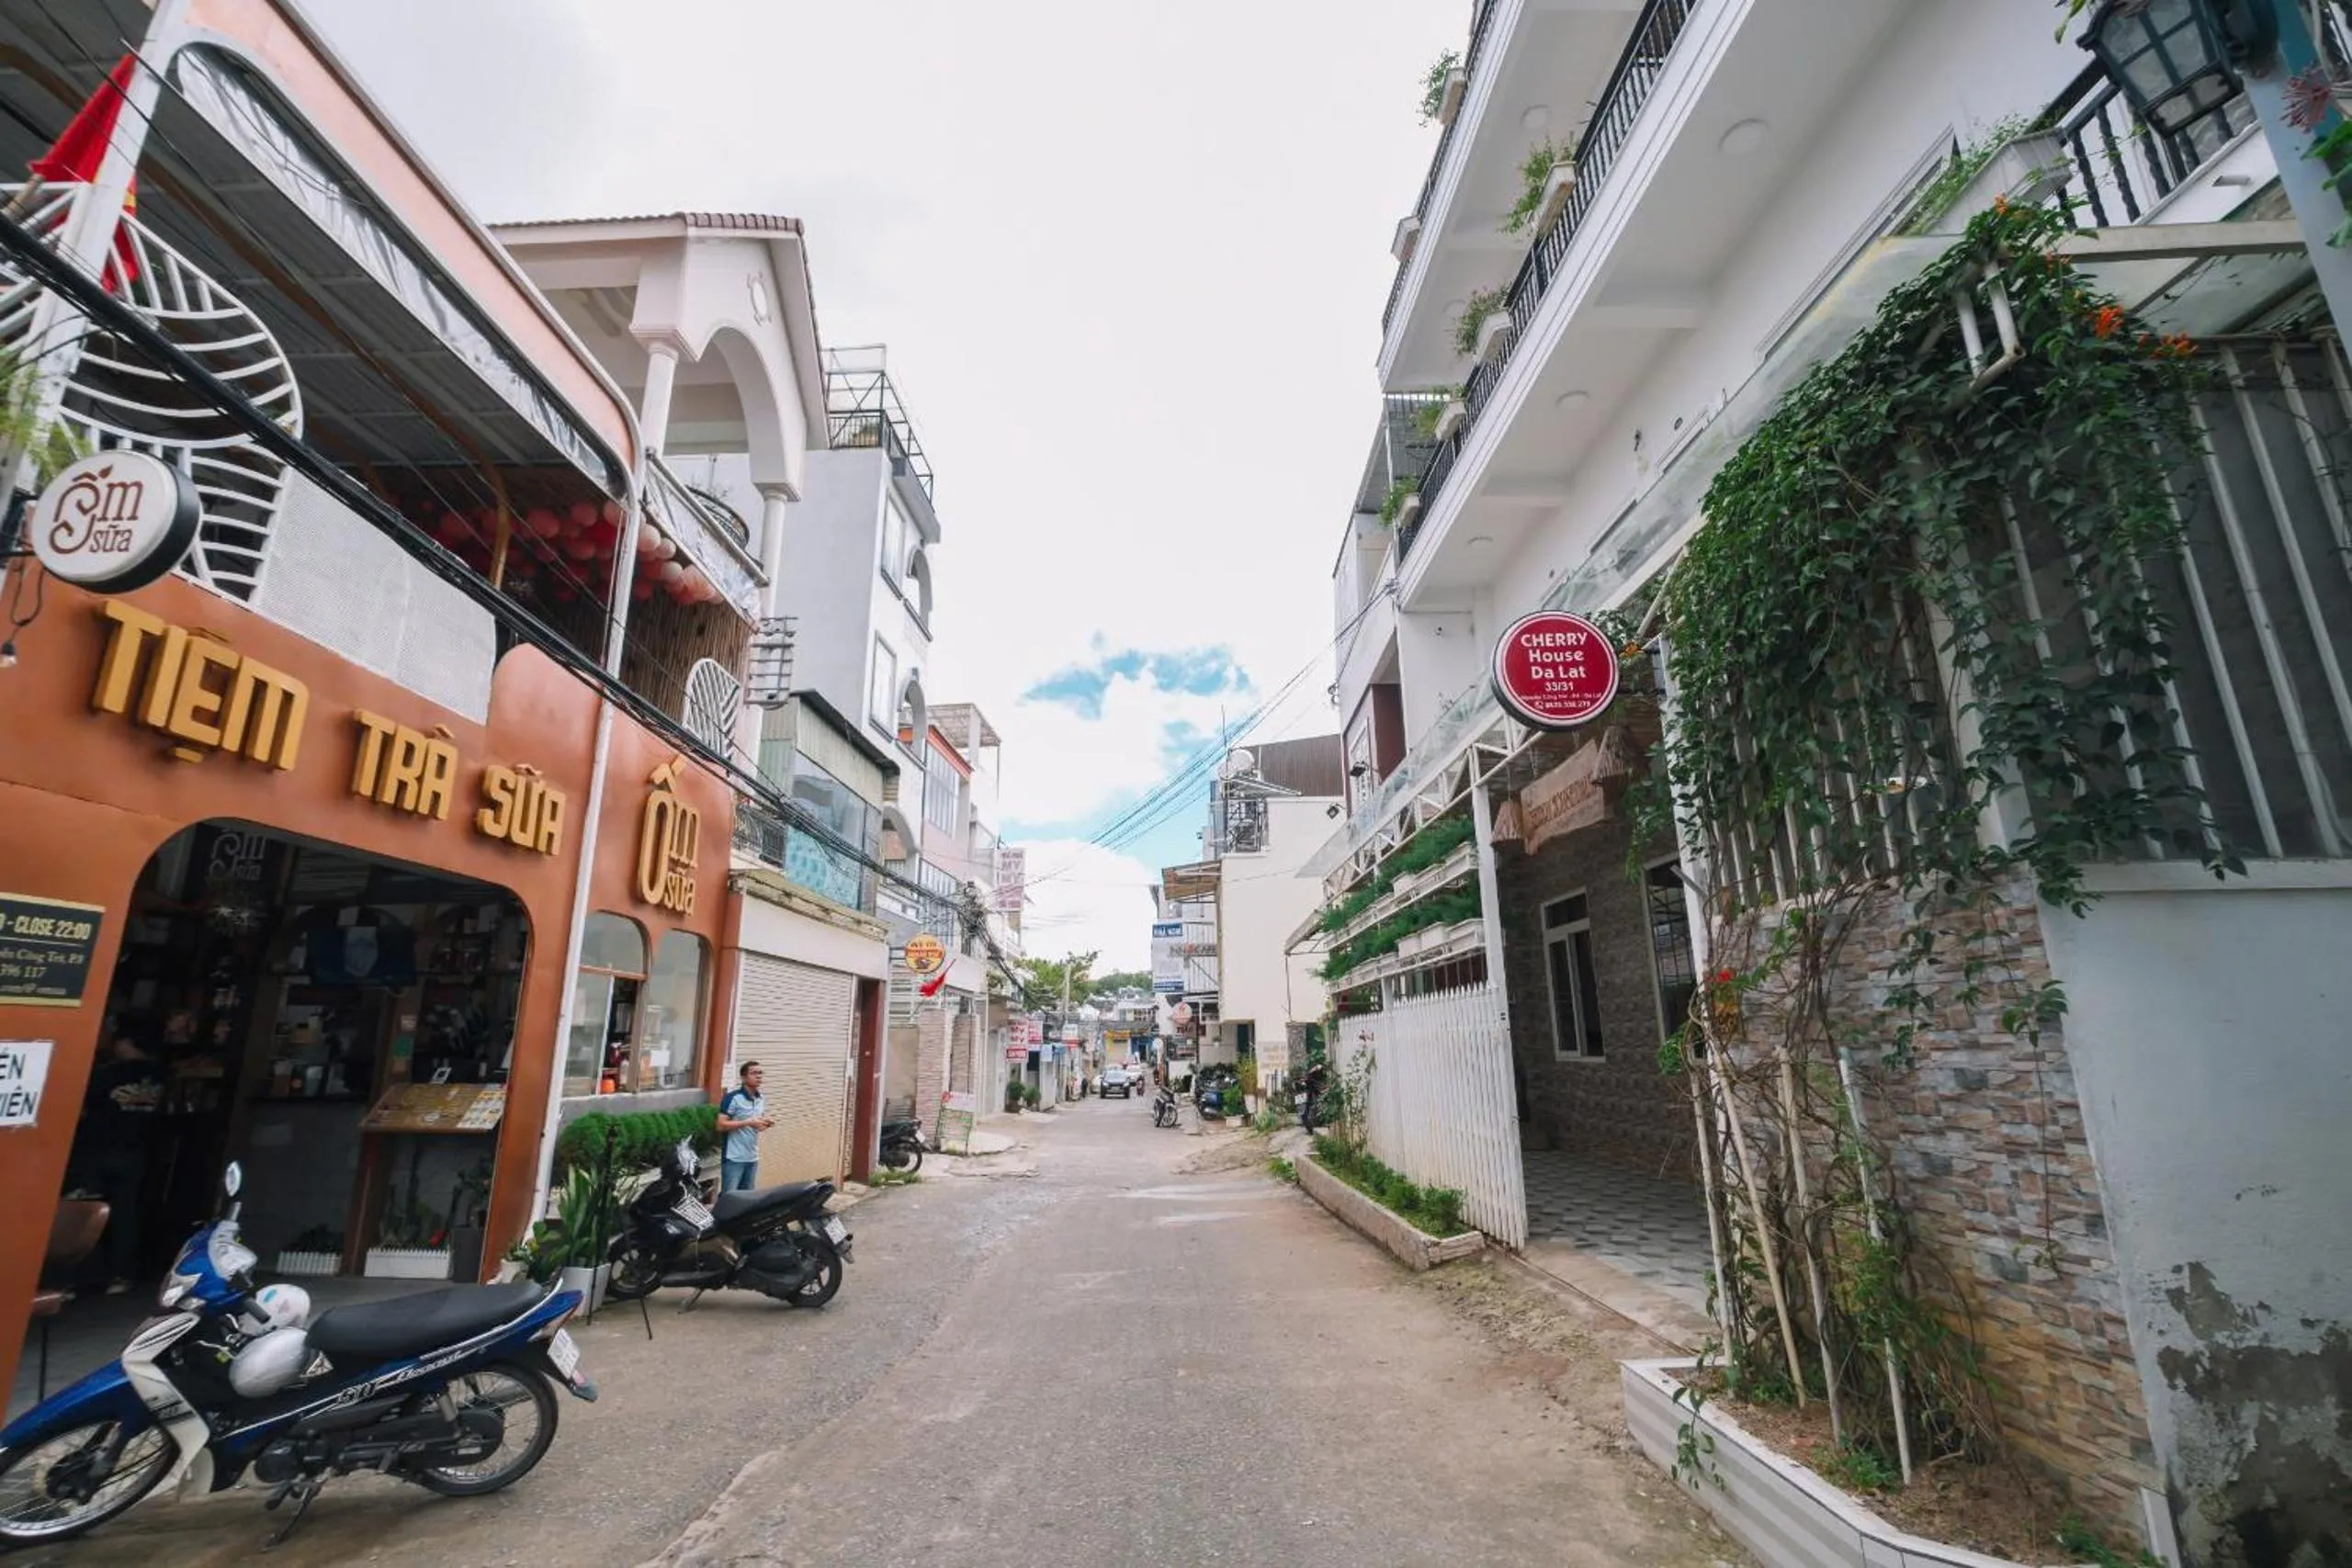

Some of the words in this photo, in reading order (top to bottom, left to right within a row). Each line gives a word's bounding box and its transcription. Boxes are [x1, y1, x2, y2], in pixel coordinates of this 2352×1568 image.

[90, 525, 133, 553] sữa
[1521, 632, 1588, 648] CHERRY
[1529, 649, 1585, 662] House
[1531, 666, 1555, 680] Da
[1559, 666, 1587, 679] Lat
[1544, 682, 1574, 692] 33/31
[352, 708, 459, 820] TRÀ
[474, 763, 568, 857] SỮA
[14, 916, 56, 936] CLOSE
